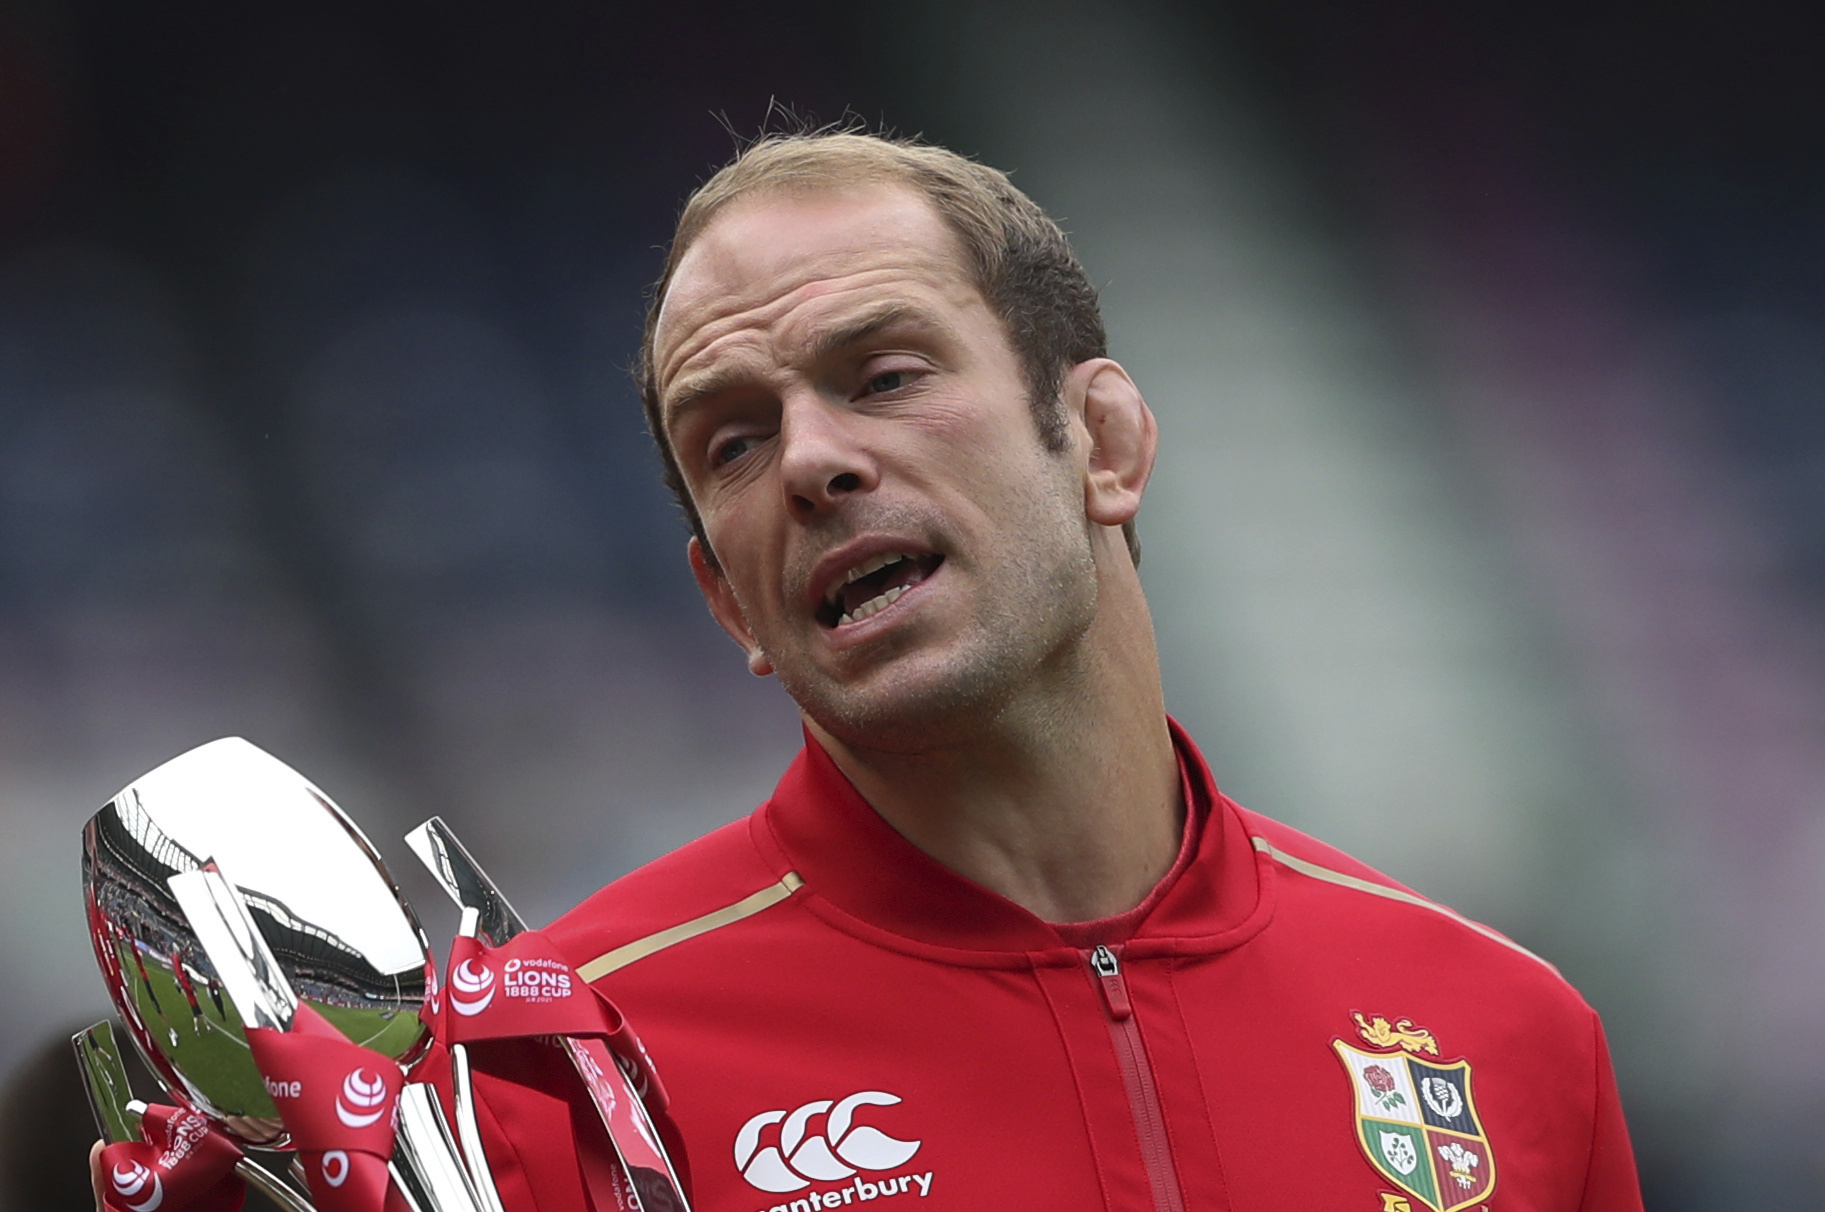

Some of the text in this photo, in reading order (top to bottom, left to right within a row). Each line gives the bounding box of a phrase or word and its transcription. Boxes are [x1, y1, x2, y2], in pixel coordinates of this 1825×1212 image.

[523, 958, 569, 972] vodafone
[504, 970, 571, 988] LIONS
[504, 986, 572, 998] 1888 CUP
[188, 1126, 209, 1143] CUP
